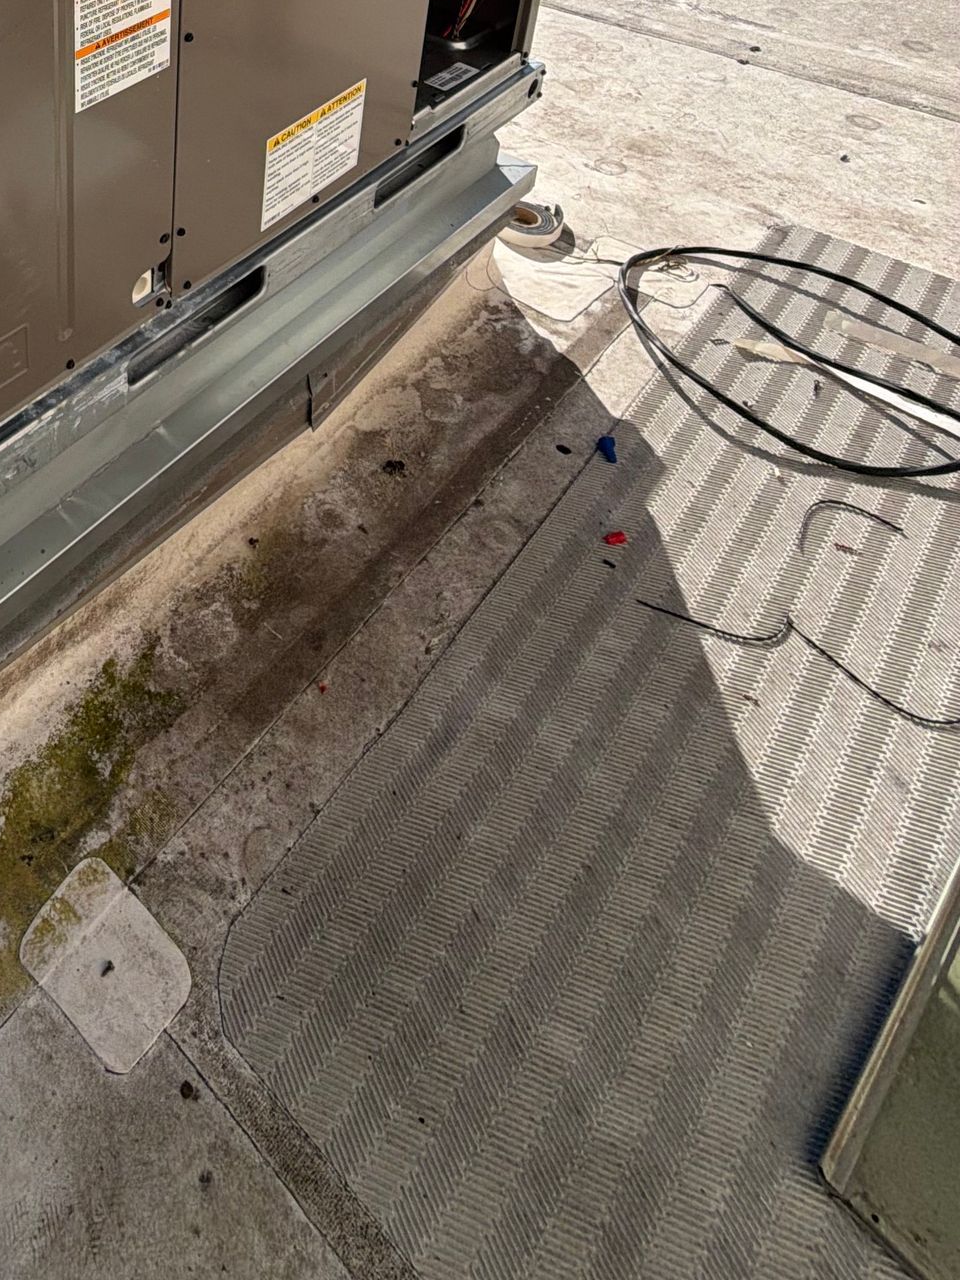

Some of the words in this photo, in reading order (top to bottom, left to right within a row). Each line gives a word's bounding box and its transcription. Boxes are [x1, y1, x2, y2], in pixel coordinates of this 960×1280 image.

[101, 16, 152, 47] AVERTISSEMENT
[326, 85, 362, 112] ATTENTION
[280, 118, 312, 142] CAUTION
